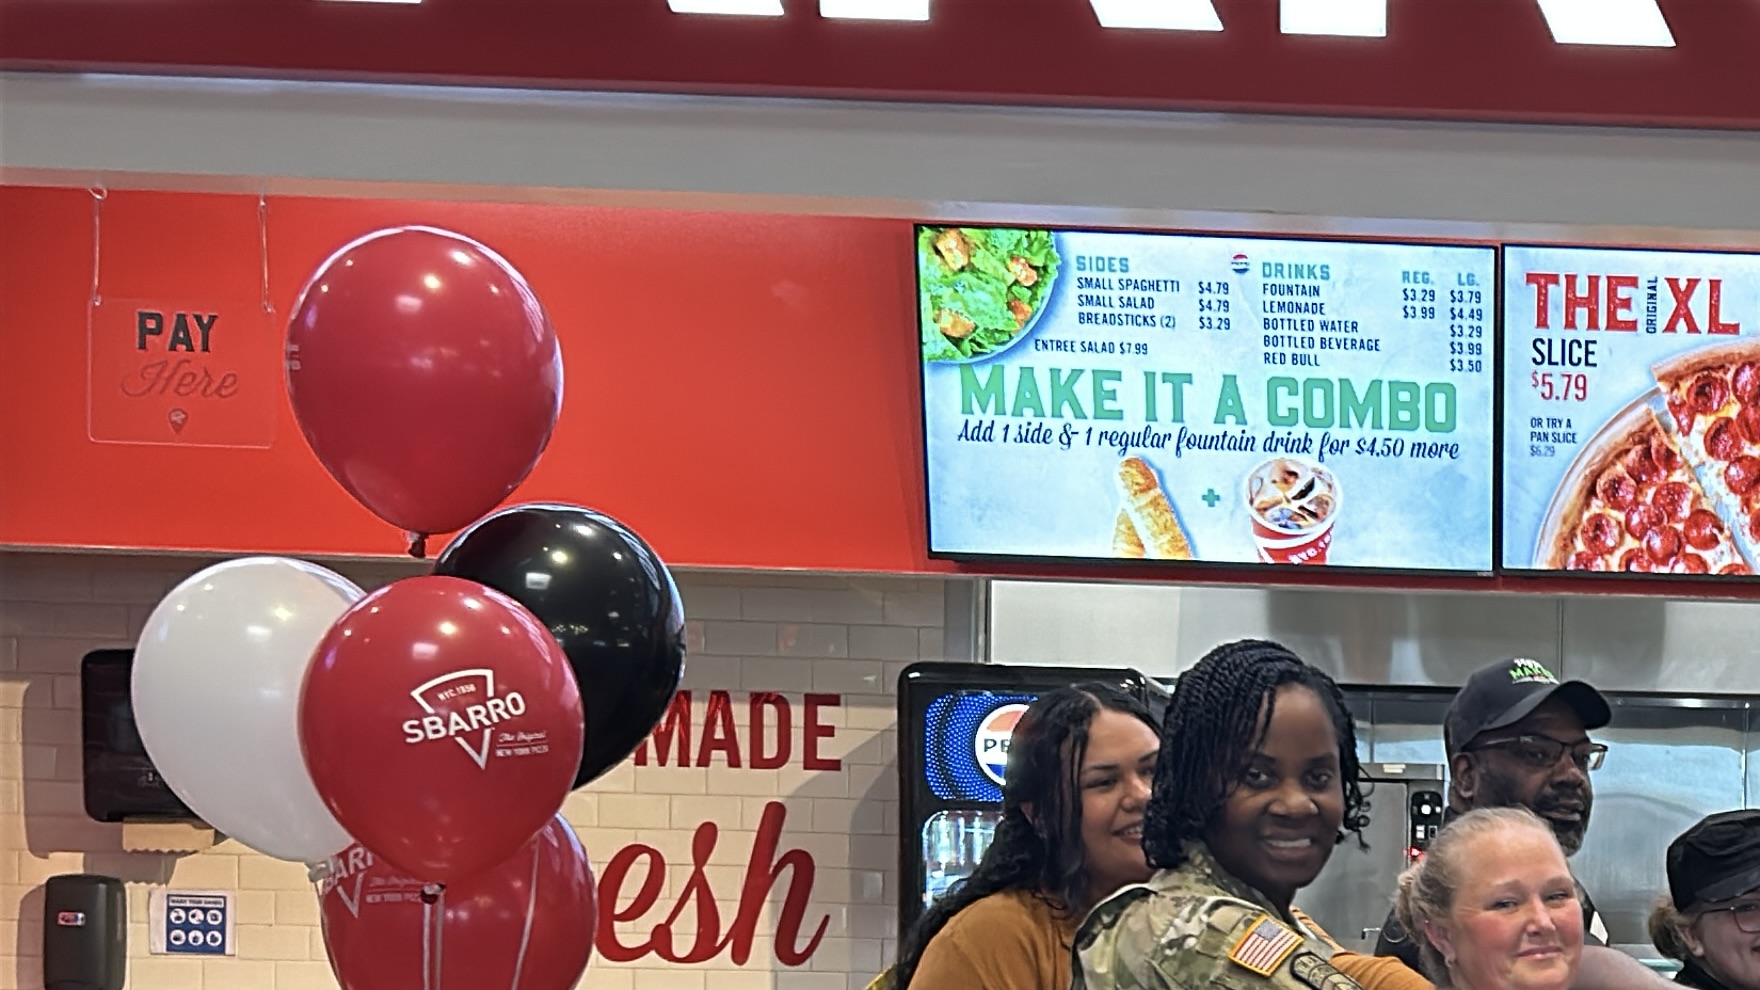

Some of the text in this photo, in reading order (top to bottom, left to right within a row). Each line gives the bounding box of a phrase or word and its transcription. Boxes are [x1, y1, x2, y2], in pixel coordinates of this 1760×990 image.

[1076, 255, 1129, 273] SIDES
[1262, 261, 1480, 286] DRINKS REG. LG.
[1077, 277, 1229, 295] SMALL SPAGHETTI $4.79
[1262, 283, 1482, 304] FOUNTAIN $3.29 $3.79
[1077, 295, 1230, 313] SMALL SALAD $4.79
[1262, 300, 1483, 321] LEMONADE $3.99 $4.49
[1525, 272, 1639, 332] THE
[1646, 276, 1658, 334] ORIGINAL
[1662, 276, 1741, 336] XL
[137, 311, 219, 352] PAY
[1078, 312, 1231, 330] BREADSTICKS (2) $3.29
[1263, 318, 1482, 338] BOTTLED WATER $3.29
[1034, 338, 1148, 355] ENTREE SALAD $7.99
[1263, 335, 1482, 356] BOTTLED BEVERAGE $3.99
[1531, 338, 1597, 367] SLICE
[1264, 352, 1482, 373] RED BULL $3.50
[121, 359, 238, 398] Here
[1531, 370, 1587, 401] $5.79
[960, 364, 1458, 433] MAKE IT A COMBO
[1530, 418, 1572, 429] OR TRY A
[956, 418, 996, 444] Add
[1002, 424, 1010, 443] 1
[1013, 422, 1055, 446] side
[1086, 426, 1093, 447] 1
[1098, 426, 1173, 455] regular
[1174, 428, 1257, 459] fountain
[1263, 432, 1314, 456] drink
[1316, 433, 1351, 463] for
[1355, 437, 1405, 460] $4.50
[1409, 440, 1461, 461] more
[1530, 431, 1577, 444] PAN SLICE
[402, 692, 526, 744] SBARRO
[633, 690, 842, 771] MADE
